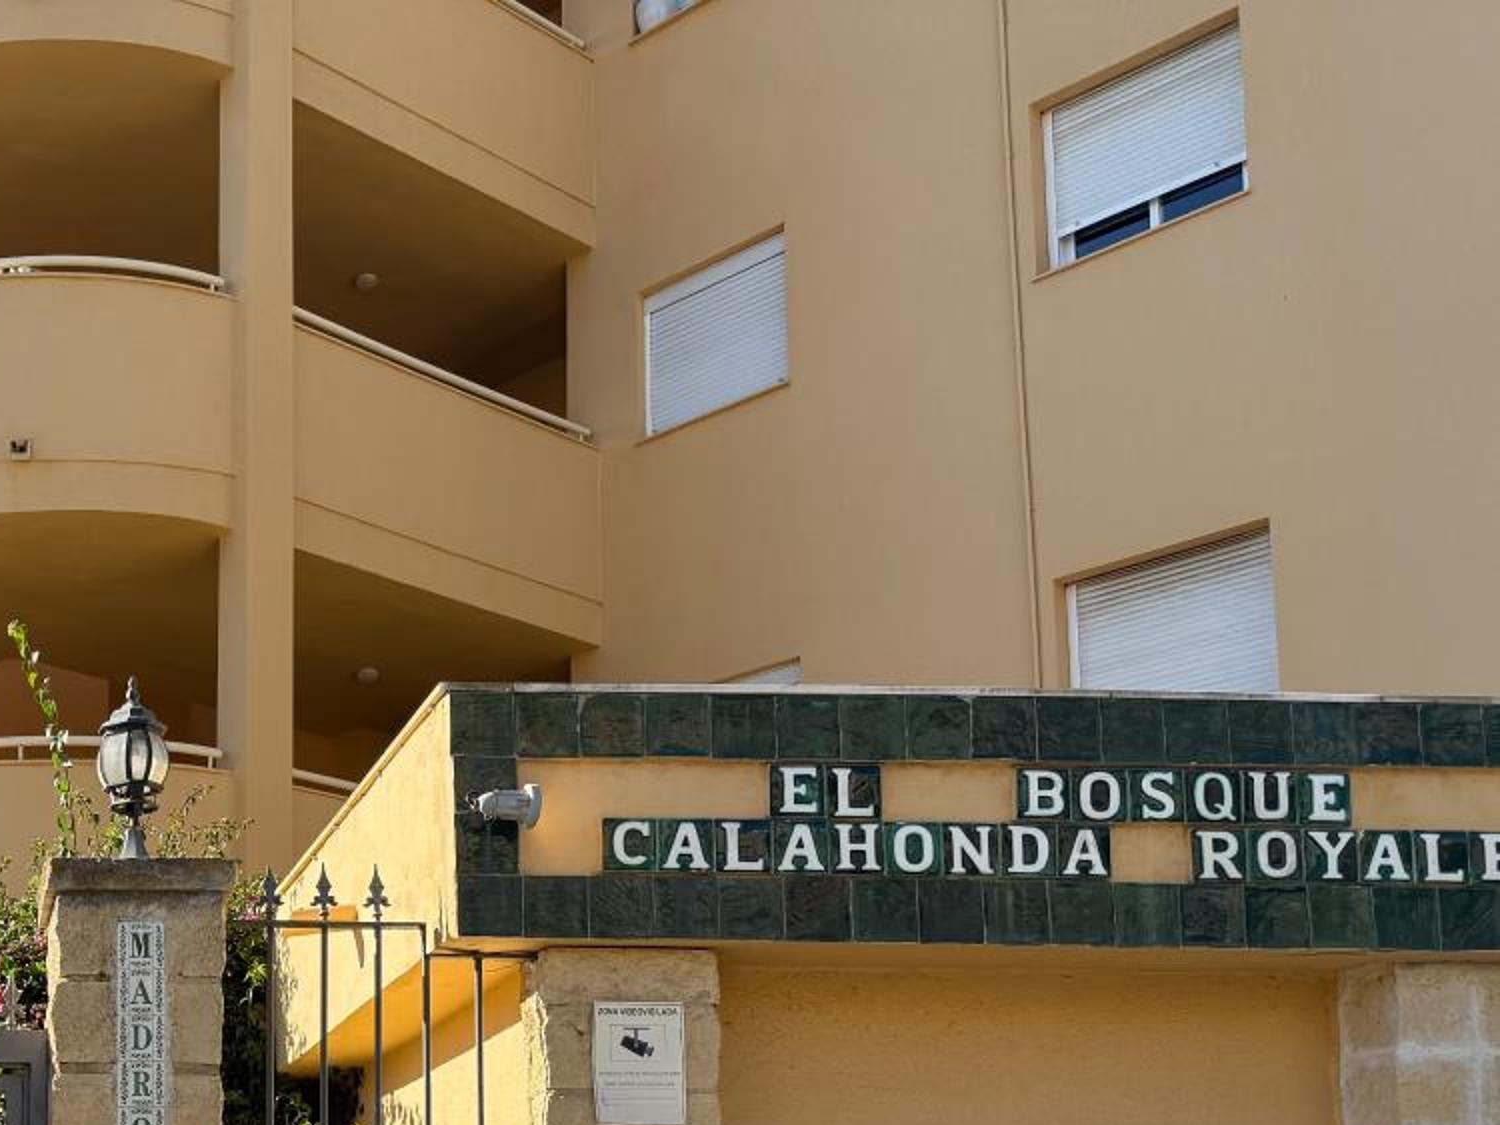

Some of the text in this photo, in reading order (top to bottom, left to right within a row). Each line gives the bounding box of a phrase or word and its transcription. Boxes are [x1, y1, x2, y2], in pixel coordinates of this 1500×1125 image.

[779, 767, 1348, 822] EL BOSQUE
[612, 820, 1109, 876] CALAHONDA
